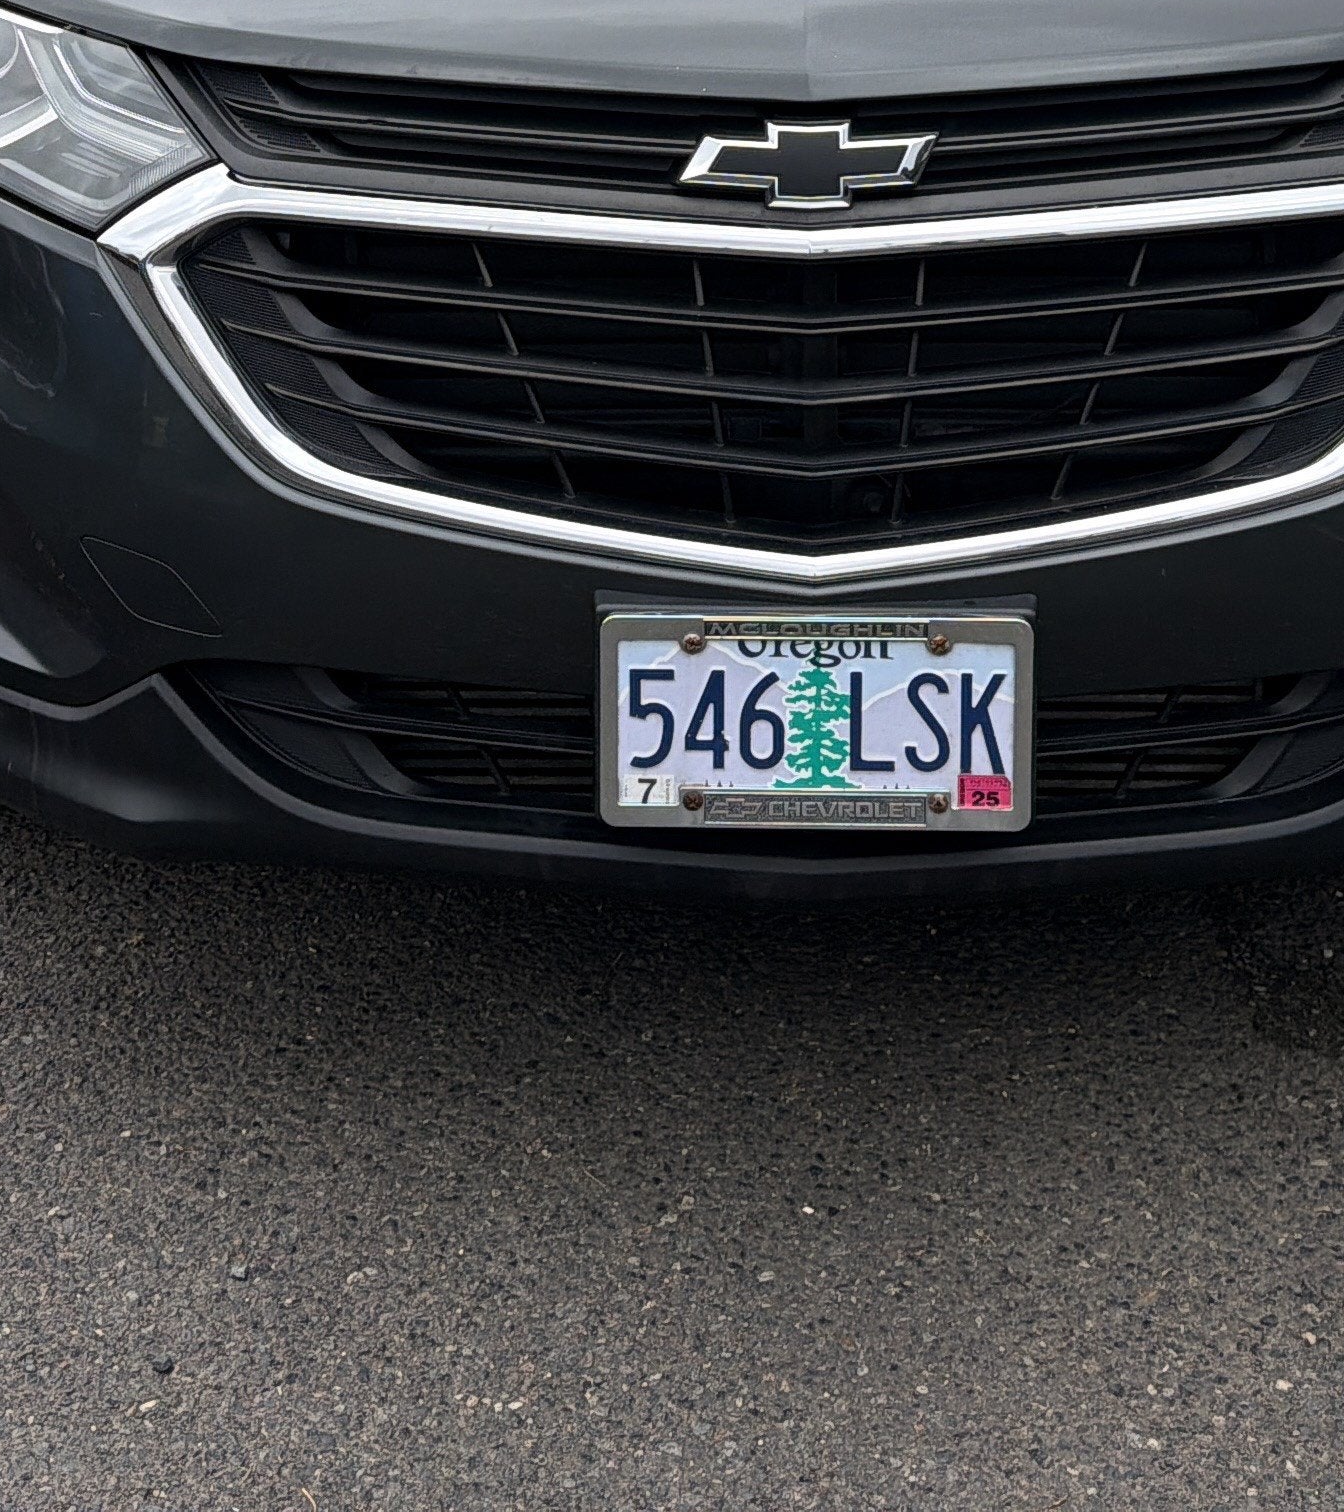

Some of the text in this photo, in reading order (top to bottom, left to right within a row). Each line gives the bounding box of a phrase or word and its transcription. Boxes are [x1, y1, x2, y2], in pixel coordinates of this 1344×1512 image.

[737, 639, 894, 668] Oregon
[628, 668, 1009, 775] 546 LSK
[637, 777, 658, 805] 7
[971, 790, 1000, 807] 25
[767, 800, 924, 819] CHEVROLET
